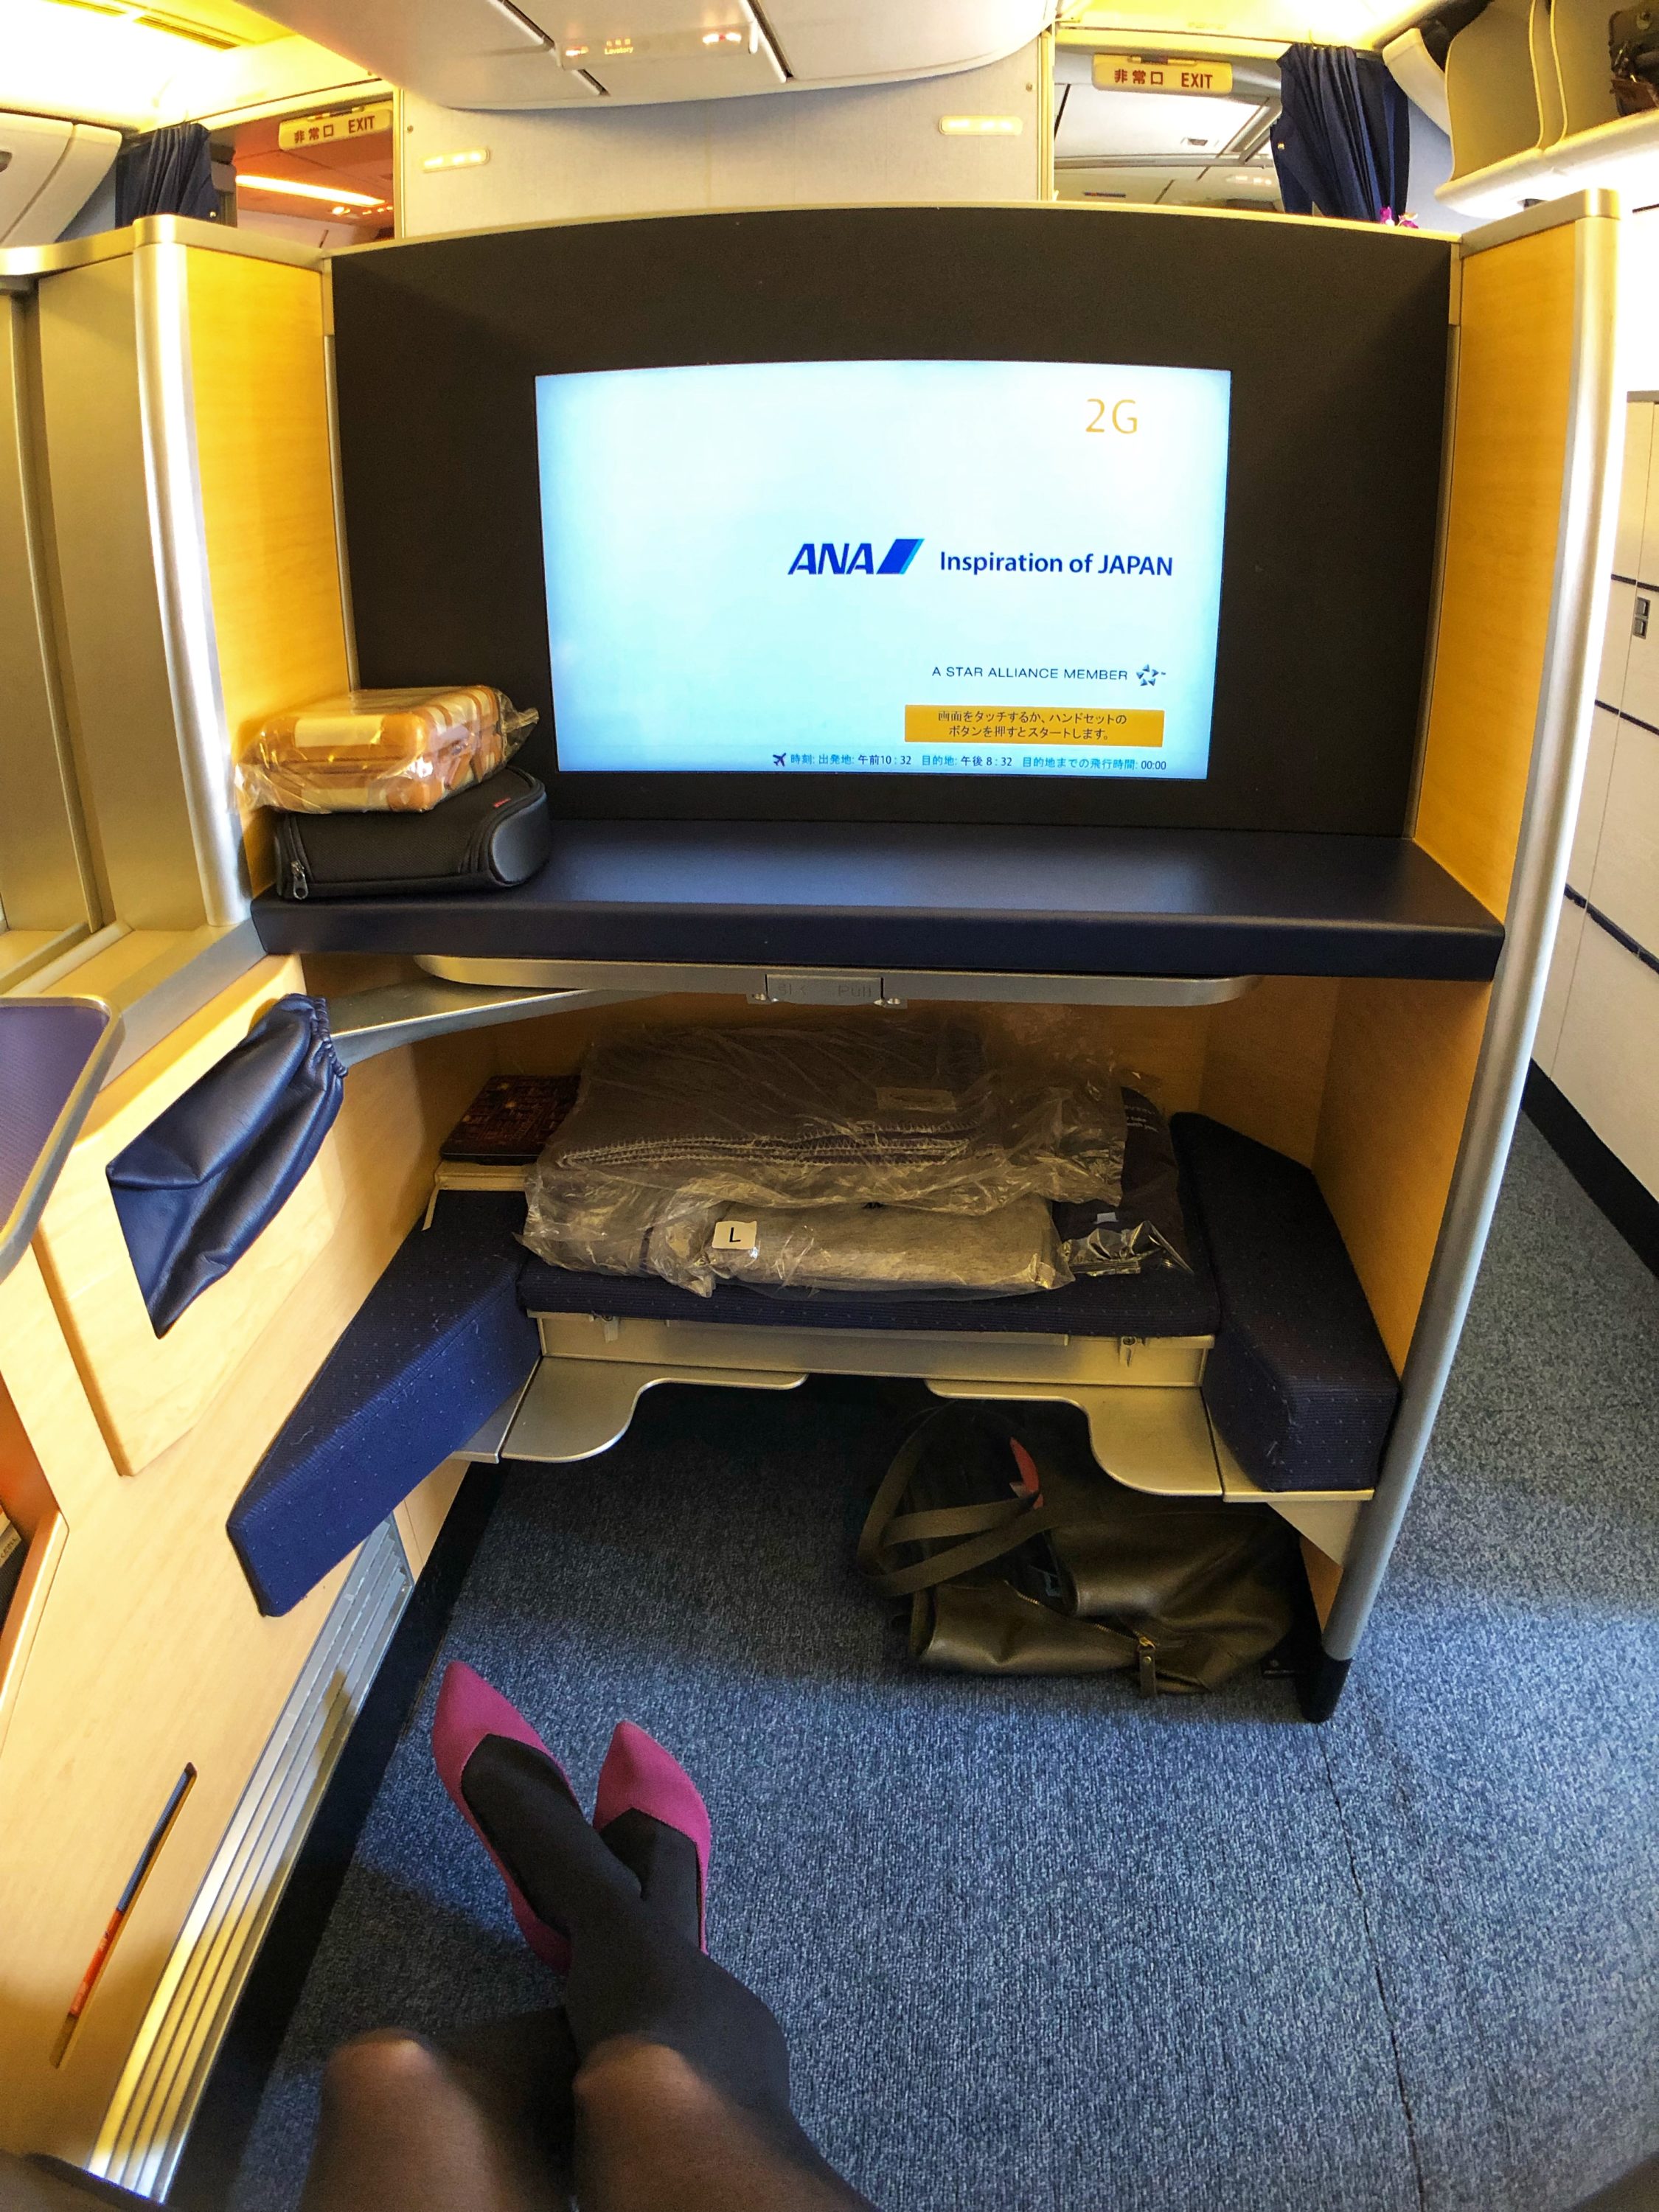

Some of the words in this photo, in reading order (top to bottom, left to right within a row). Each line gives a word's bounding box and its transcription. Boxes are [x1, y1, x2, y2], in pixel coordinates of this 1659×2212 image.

[1114, 69, 1164, 86] 非常口
[1181, 72, 1213, 89] EXIT
[294, 124, 334, 144] 非常口
[348, 115, 375, 133] EXIT
[1085, 398, 1138, 434] 2G
[787, 543, 874, 575] ANA
[940, 551, 1063, 575] Inspiration
[1068, 552, 1094, 573] of
[1097, 554, 1173, 576] JAPAN
[932, 667, 942, 677] A
[946, 667, 983, 678] STAR
[988, 667, 1059, 678] ALLIANCE
[1064, 669, 1128, 680] MEMBER
[938, 710, 1127, 725] 画面をタッチするか、ハンドセットの
[949, 726, 1108, 740] ボタンを押すとスタートします。
[1141, 760, 1166, 770] 00:00
[838, 984, 872, 997] Pull
[728, 1226, 741, 1243] L
